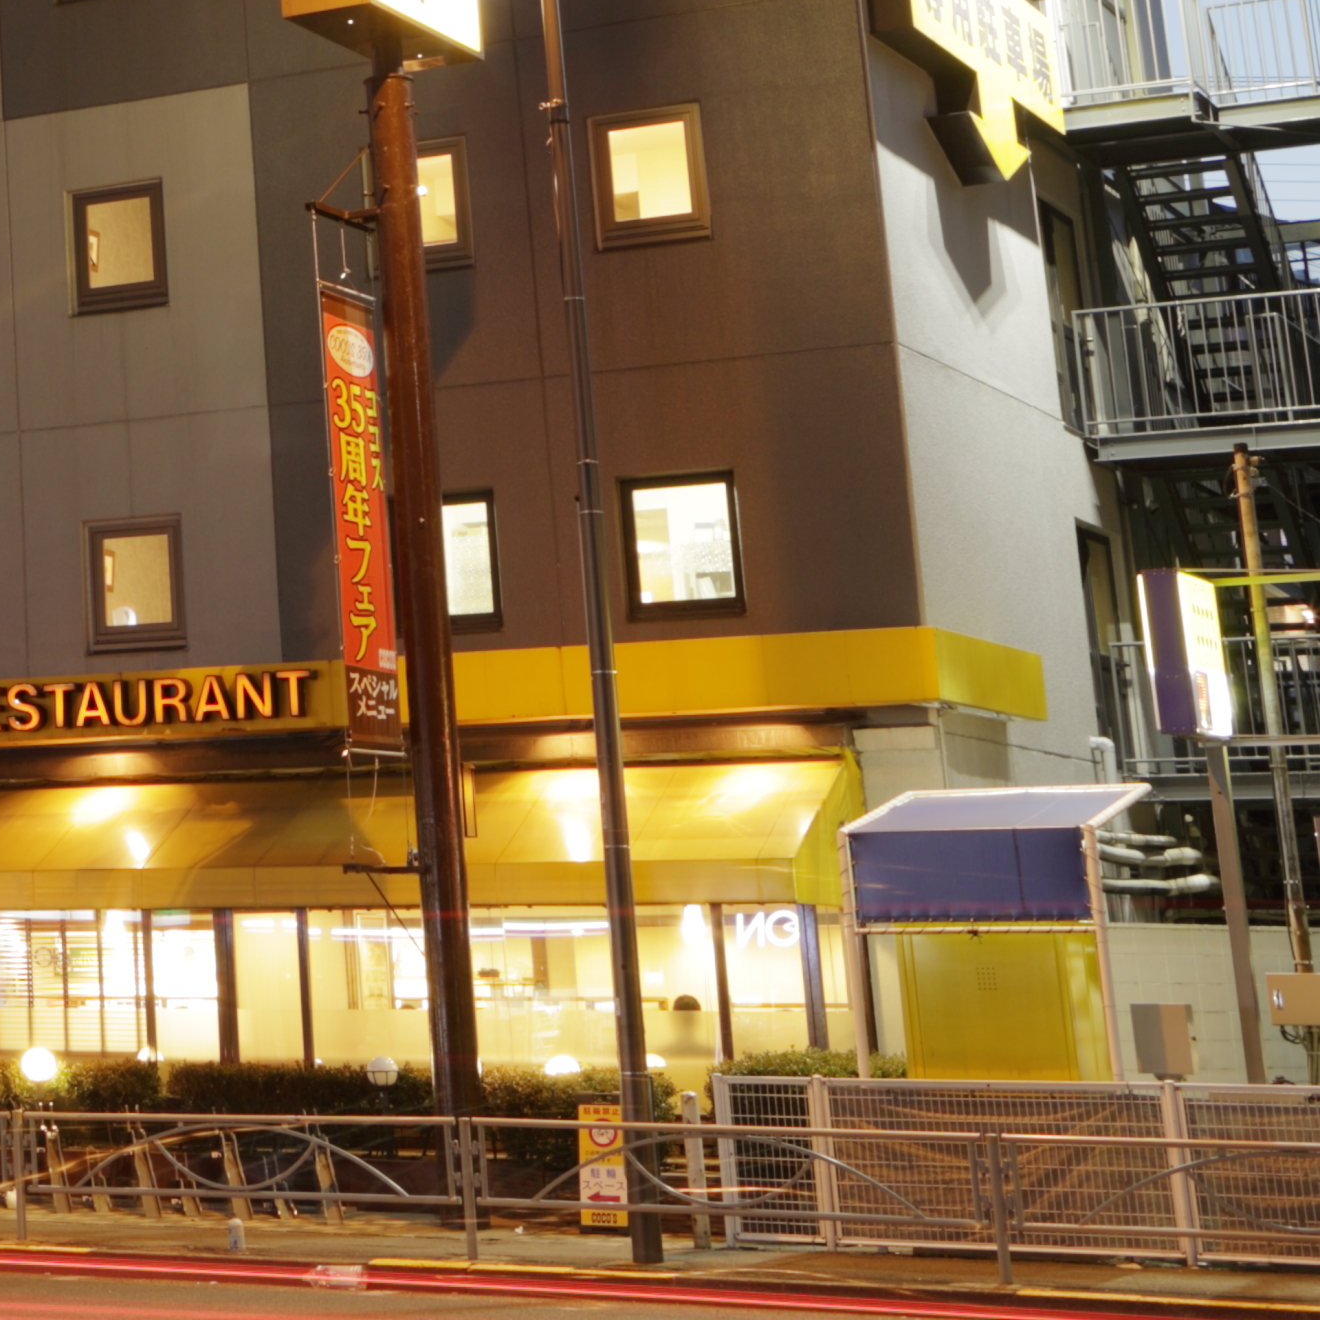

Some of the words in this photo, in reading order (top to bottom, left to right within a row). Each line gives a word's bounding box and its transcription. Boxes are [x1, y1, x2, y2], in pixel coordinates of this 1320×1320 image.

[363, 388, 383, 492] ココス
[331, 377, 378, 662] 35周年フェア
[349, 672, 398, 701] スペシャル
[356, 695, 396, 720] メニュー
[582, 1181, 625, 1191] スペース
[591, 1213, 617, 1223] COCO'S
